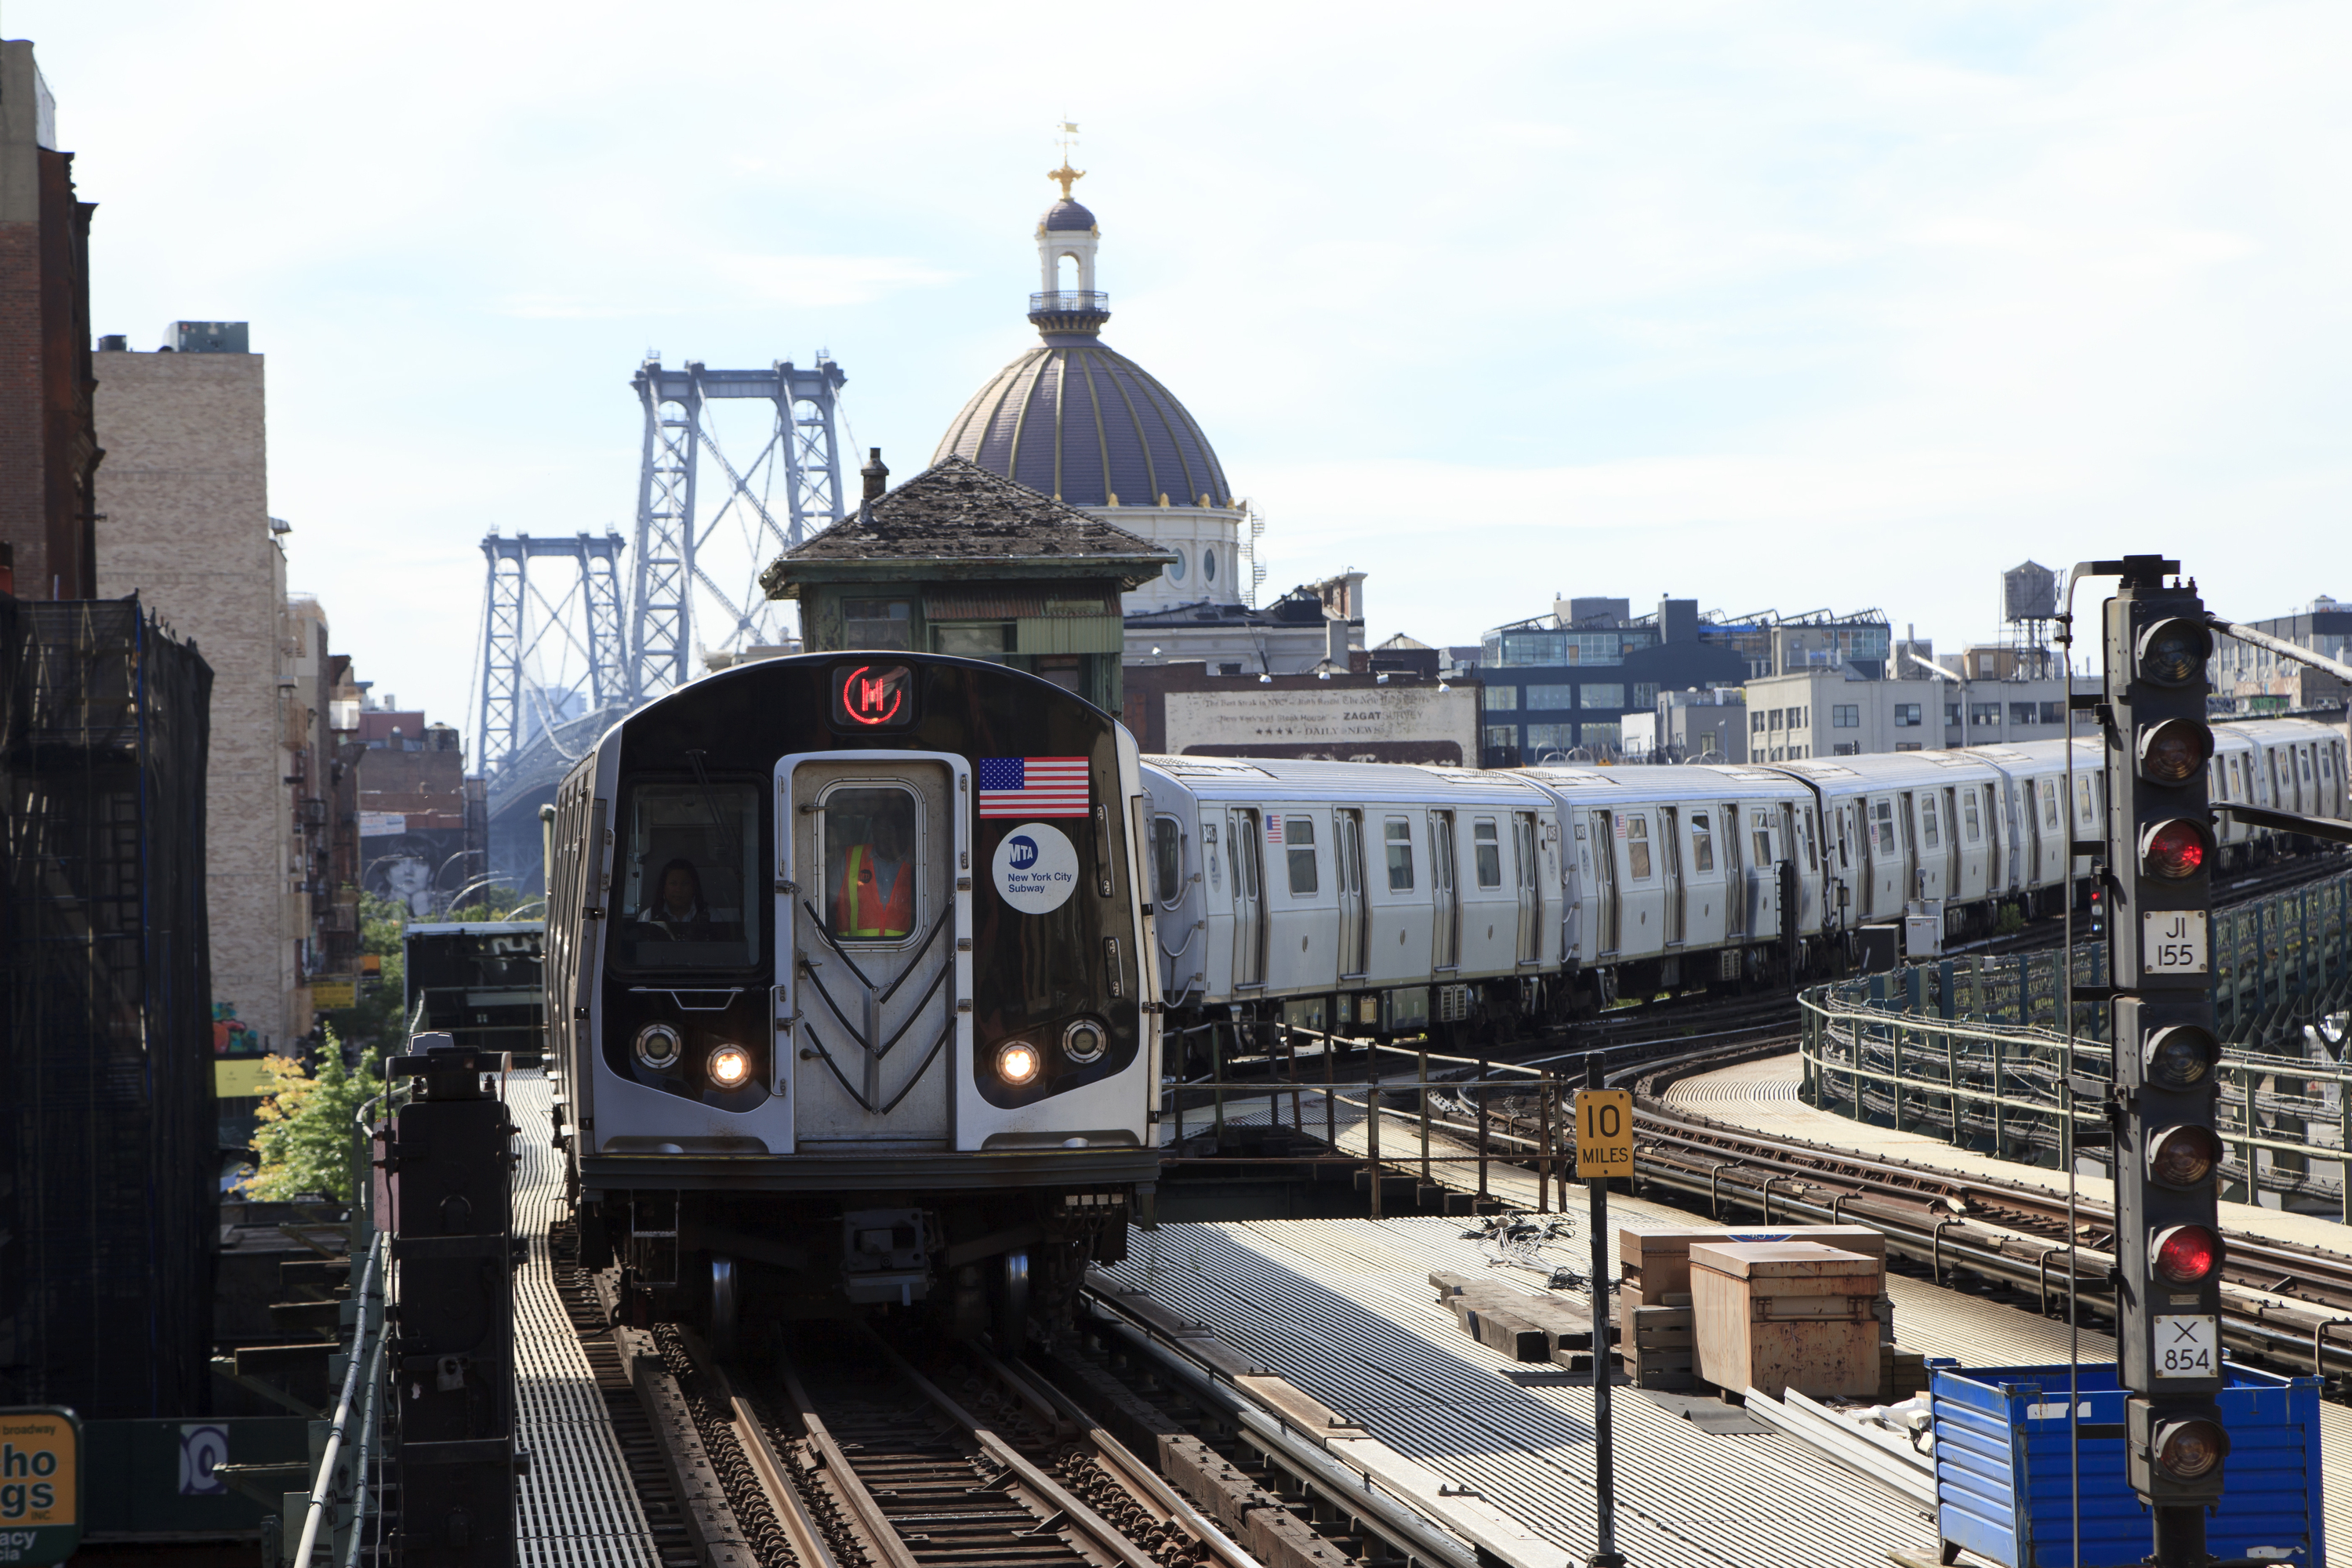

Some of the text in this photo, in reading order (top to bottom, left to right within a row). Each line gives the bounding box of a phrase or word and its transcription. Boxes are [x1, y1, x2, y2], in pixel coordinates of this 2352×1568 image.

[862, 678, 884, 711] M
[1008, 843, 1033, 863] MTA
[1007, 872, 1073, 883] New York City
[1008, 884, 1045, 894] Subway
[1588, 1104, 1621, 1138] 10
[1582, 1147, 1629, 1163] MILES
[2172, 1321, 2199, 1343] X
[2165, 1348, 2210, 1370] 854
[2, 1424, 56, 1436] broadway
[0, 1441, 58, 1479] ho
